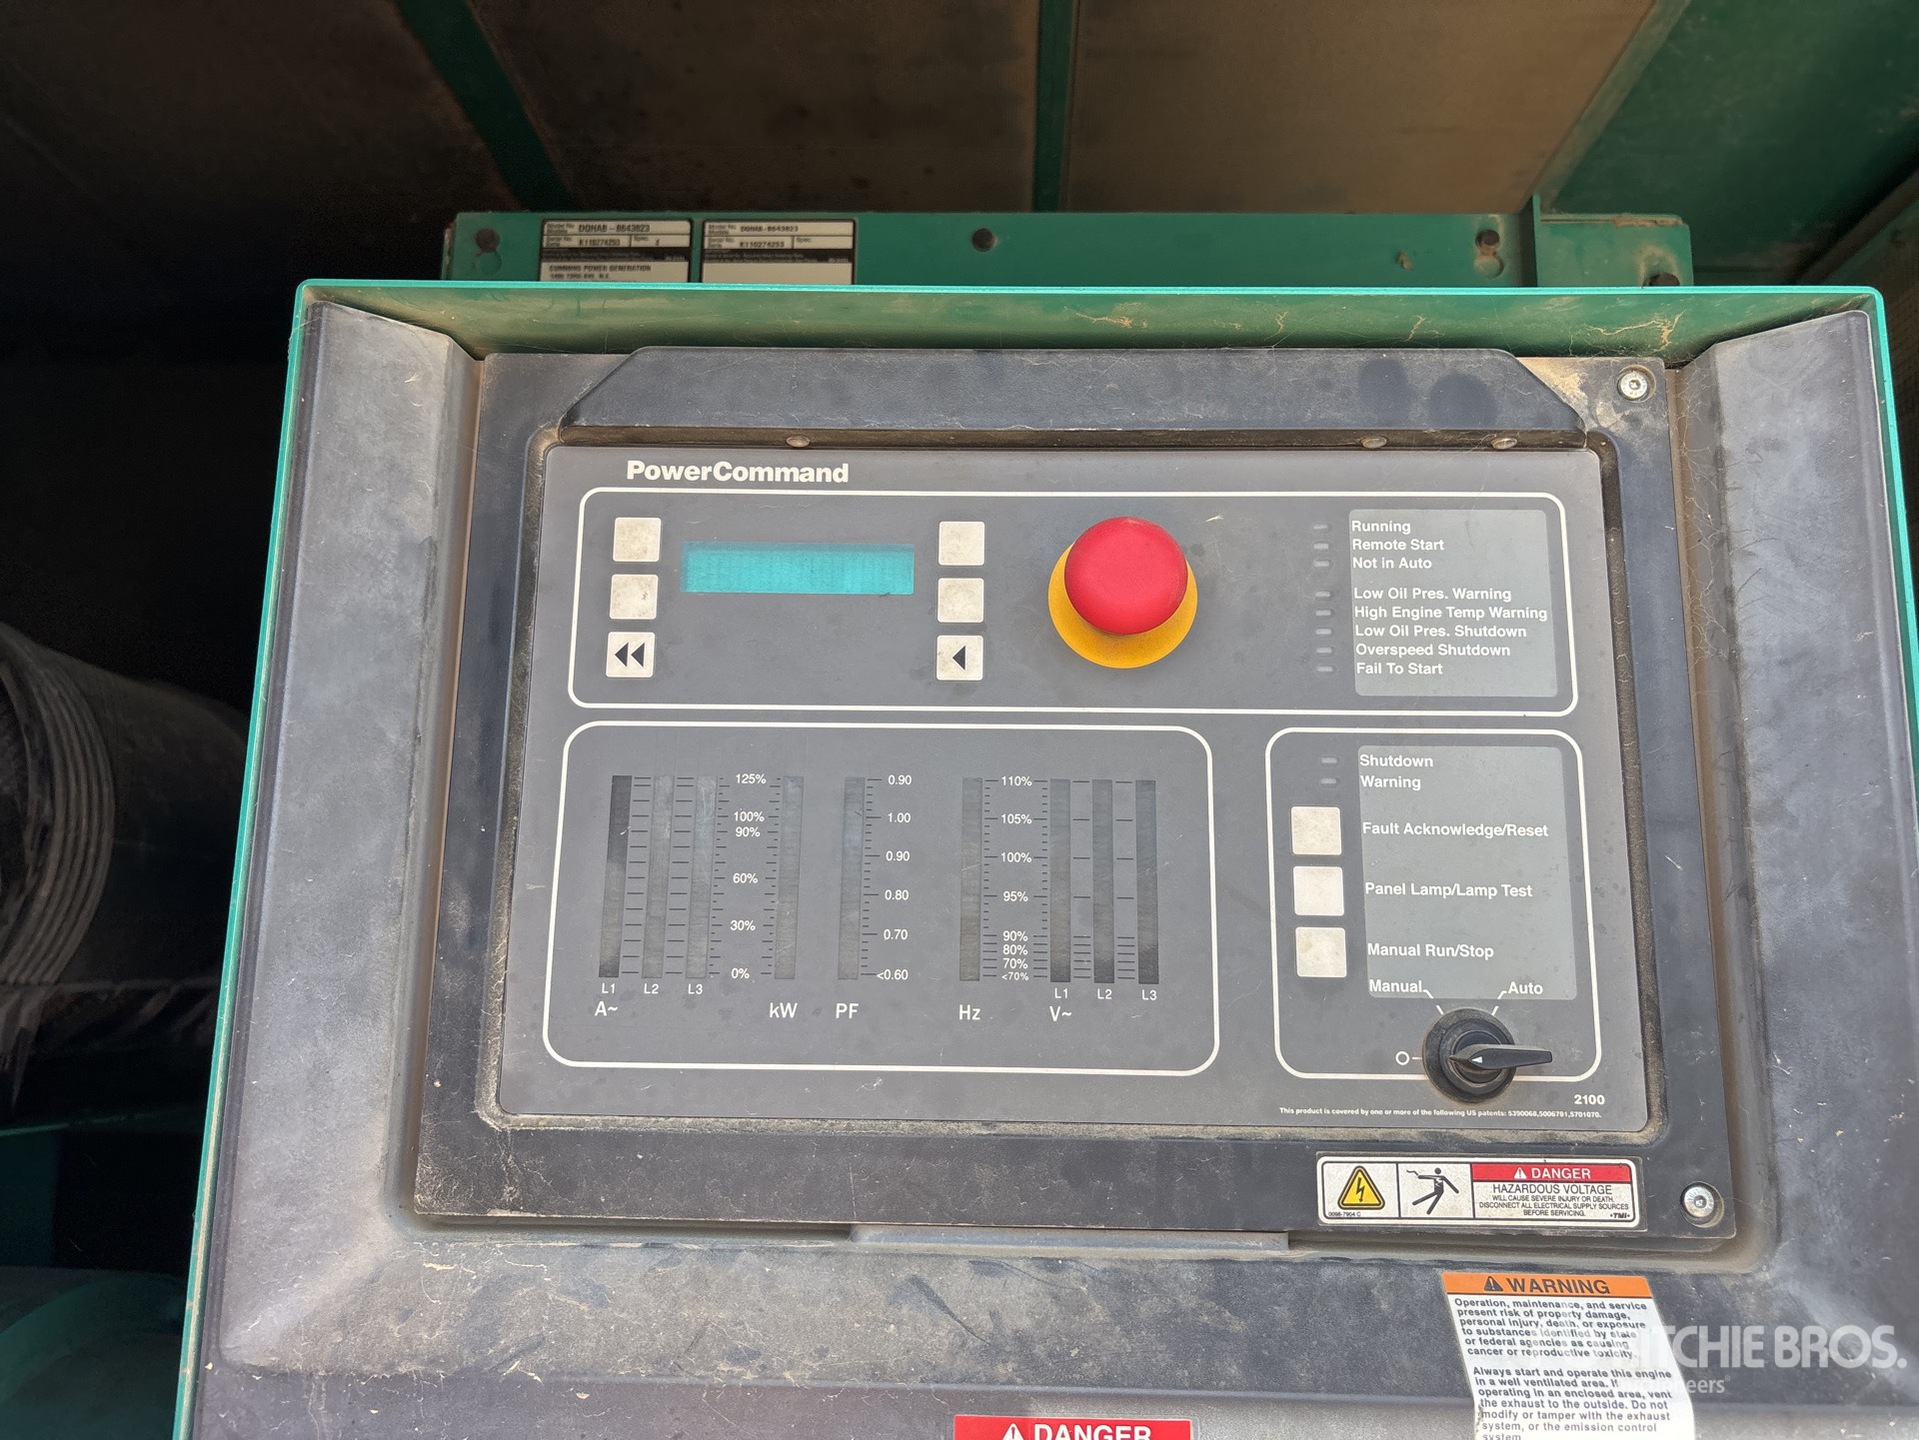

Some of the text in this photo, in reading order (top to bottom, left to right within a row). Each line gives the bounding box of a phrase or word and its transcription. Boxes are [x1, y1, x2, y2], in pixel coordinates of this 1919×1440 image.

[627, 460, 848, 483] PowerCommand
[1352, 520, 1411, 535] Running
[1353, 539, 1444, 550] Remote Start
[1353, 557, 1432, 568] Not in Auto
[1354, 587, 1511, 602] Low Oil Pres. Warning
[1355, 606, 1547, 622] High Engine Temp Warning
[1356, 625, 1526, 637] Low Oil Pres. Shutdown
[1356, 643, 1510, 658] Overspeed Shutdown
[1357, 662, 1443, 674] Fail To Start
[1360, 754, 1433, 767] Shutdown
[736, 774, 766, 784] 125%
[888, 775, 912, 785] 0.90
[1002, 776, 1032, 786] 110%
[1360, 775, 1421, 791] Warning
[734, 811, 764, 822] 100%
[888, 813, 911, 823] 1.00
[1002, 814, 1032, 824] 105%
[736, 827, 760, 837] 90%
[1363, 822, 1548, 839] Fault Acknowledge/Reset
[886, 851, 910, 861] 0.90
[1001, 852, 1032, 863] 100%
[733, 873, 758, 883] 60%
[885, 890, 909, 900] 0.80
[1365, 882, 1533, 899] Panel Lamp/Lamp Test
[1003, 891, 1028, 902] 95%
[730, 920, 755, 931] 30%
[884, 929, 908, 940] 0.70
[1003, 931, 1028, 941] 90%
[1003, 944, 1028, 955] 80%
[1368, 943, 1494, 960] Manual Run/Stop
[1003, 958, 1028, 969] 70%
[731, 968, 750, 979] 0%
[1002, 972, 1029, 981] <70%
[602, 983, 703, 994] L1 L2 L3
[1369, 979, 1543, 994] Manual Auto
[1055, 988, 1157, 1000] L1 L2 L3
[770, 1003, 797, 1018] kW
[836, 1003, 859, 1018] PF
[959, 1005, 980, 1020] Hz
[1574, 1094, 1605, 1105] 2100
[1532, 1168, 1591, 1179] DANGER
[1493, 1184, 1612, 1195] HAZARDOUS VOLTAGE
[1506, 1278, 1610, 1294] WARNING
[1455, 1298, 1647, 1310] Operation, maintenance, and service
[1457, 1309, 1497, 1317] present
[1537, 1311, 1581, 1320] property
[1585, 1310, 1630, 1321] damage,
[1460, 1318, 1645, 1330] personal exposure
[1476, 1328, 1637, 1338] substances identified state
[1479, 1337, 1629, 1349] federal agencies causing
[1521, 1349, 1590, 1358] reproductive
[1474, 1367, 1671, 1380] Always start and operate this engine
[1498, 1378, 1520, 1386] well
[1523, 1378, 1578, 1387] ventilated
[1478, 1388, 1531, 1398] operating
[1564, 1389, 1614, 1398] enclosed
[1618, 1391, 1645, 1399] area,
[1479, 1398, 1668, 1409] the exhaust the outside. not
[1479, 1408, 1670, 1422] modify tamper with the exhaust
[1034, 1424, 1151, 1440] DANGER
[1482, 1422, 1656, 1432] system, the emission control
